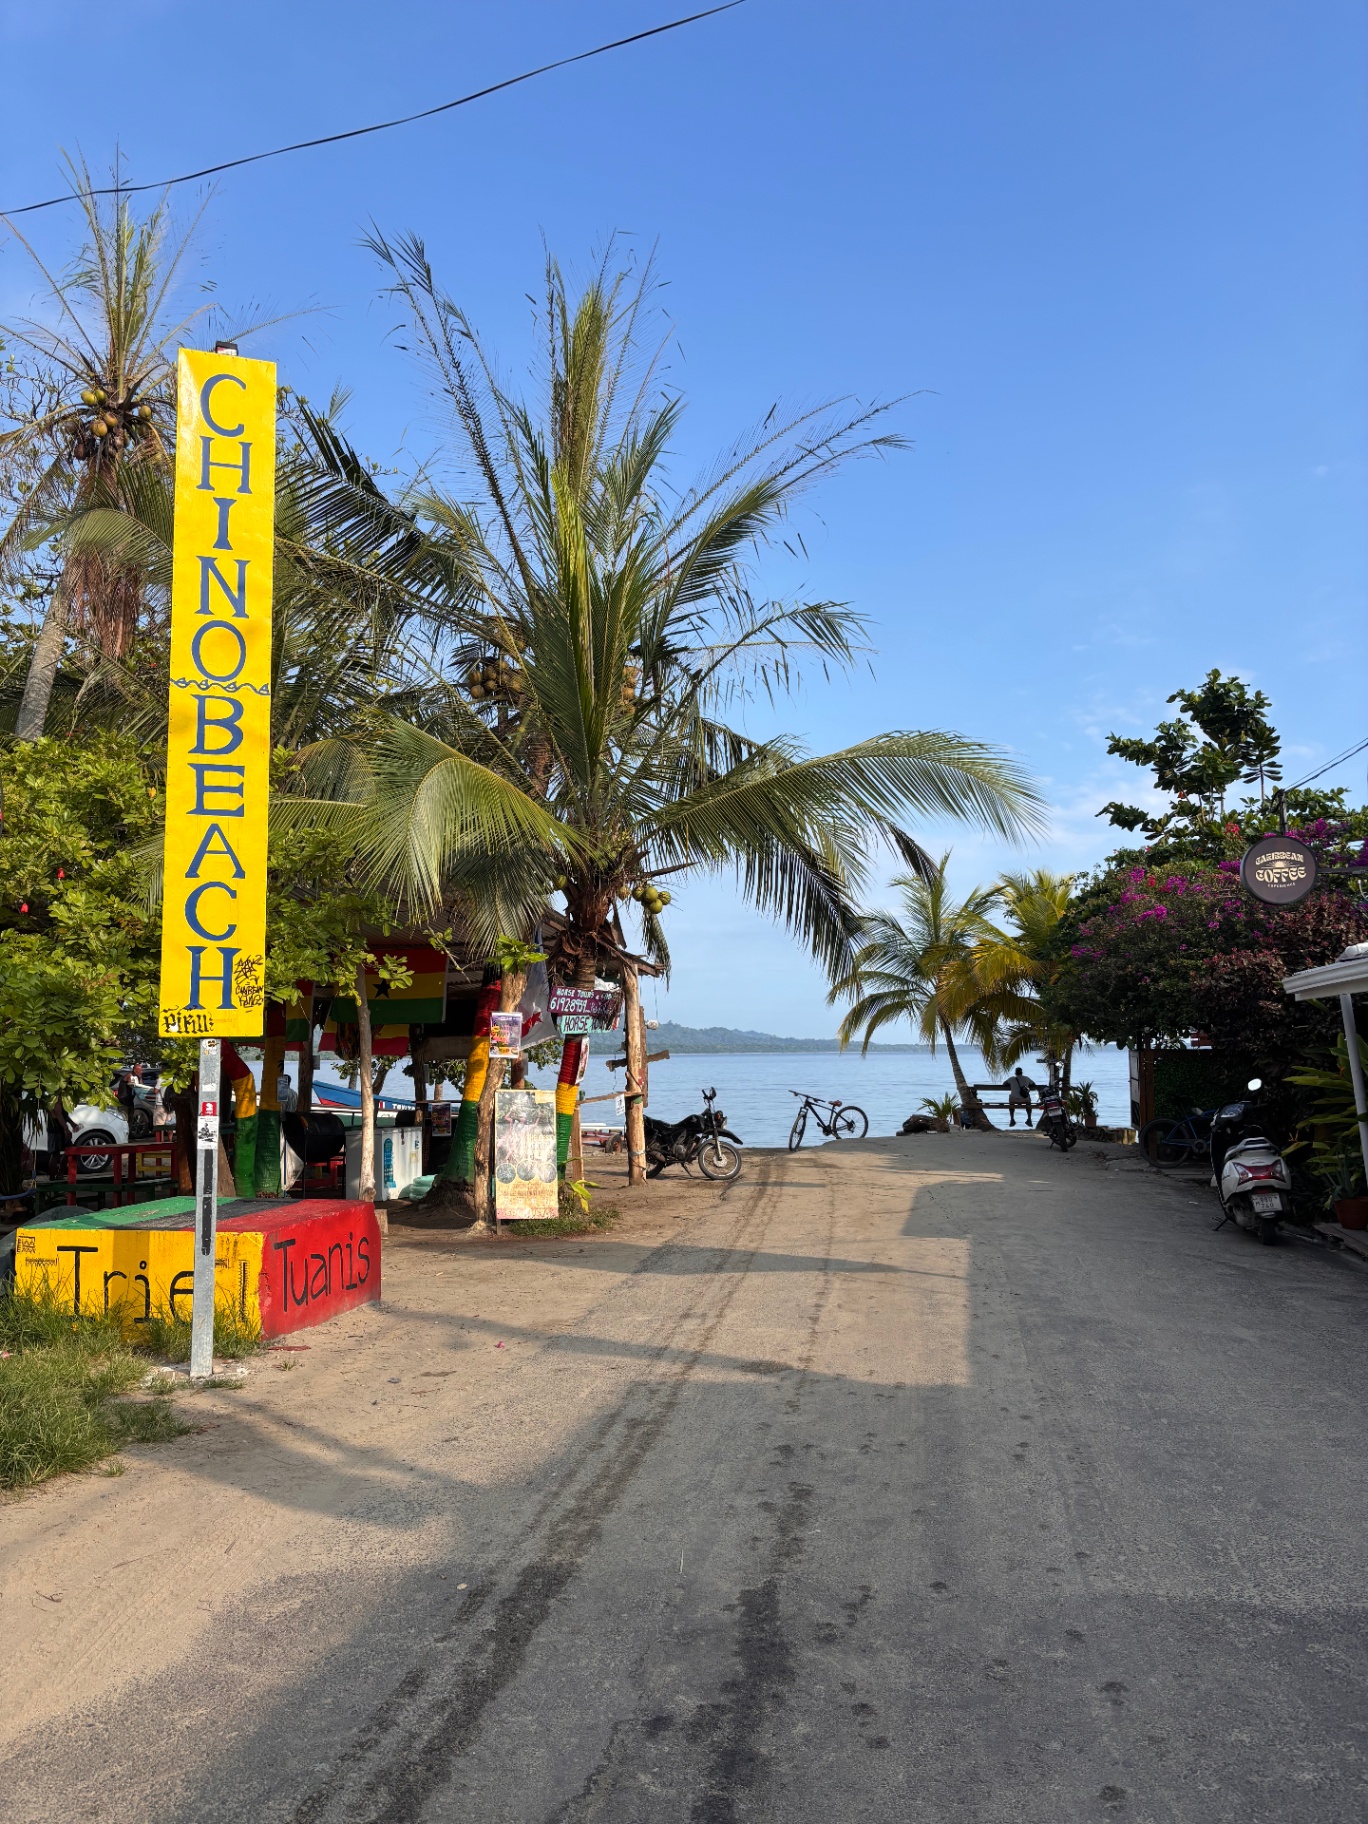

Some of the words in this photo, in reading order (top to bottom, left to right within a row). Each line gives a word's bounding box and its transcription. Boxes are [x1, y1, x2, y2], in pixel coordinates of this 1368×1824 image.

[191, 373, 253, 683] CHINO
[185, 693, 246, 1010] BEACH
[1255, 851, 1304, 865] CARIBBEAN
[1255, 867, 1307, 883] COFFEE
[577, 990, 595, 998] TOURS
[564, 1015, 590, 1033] HORSE
[273, 1231, 371, 1313] Tuanis
